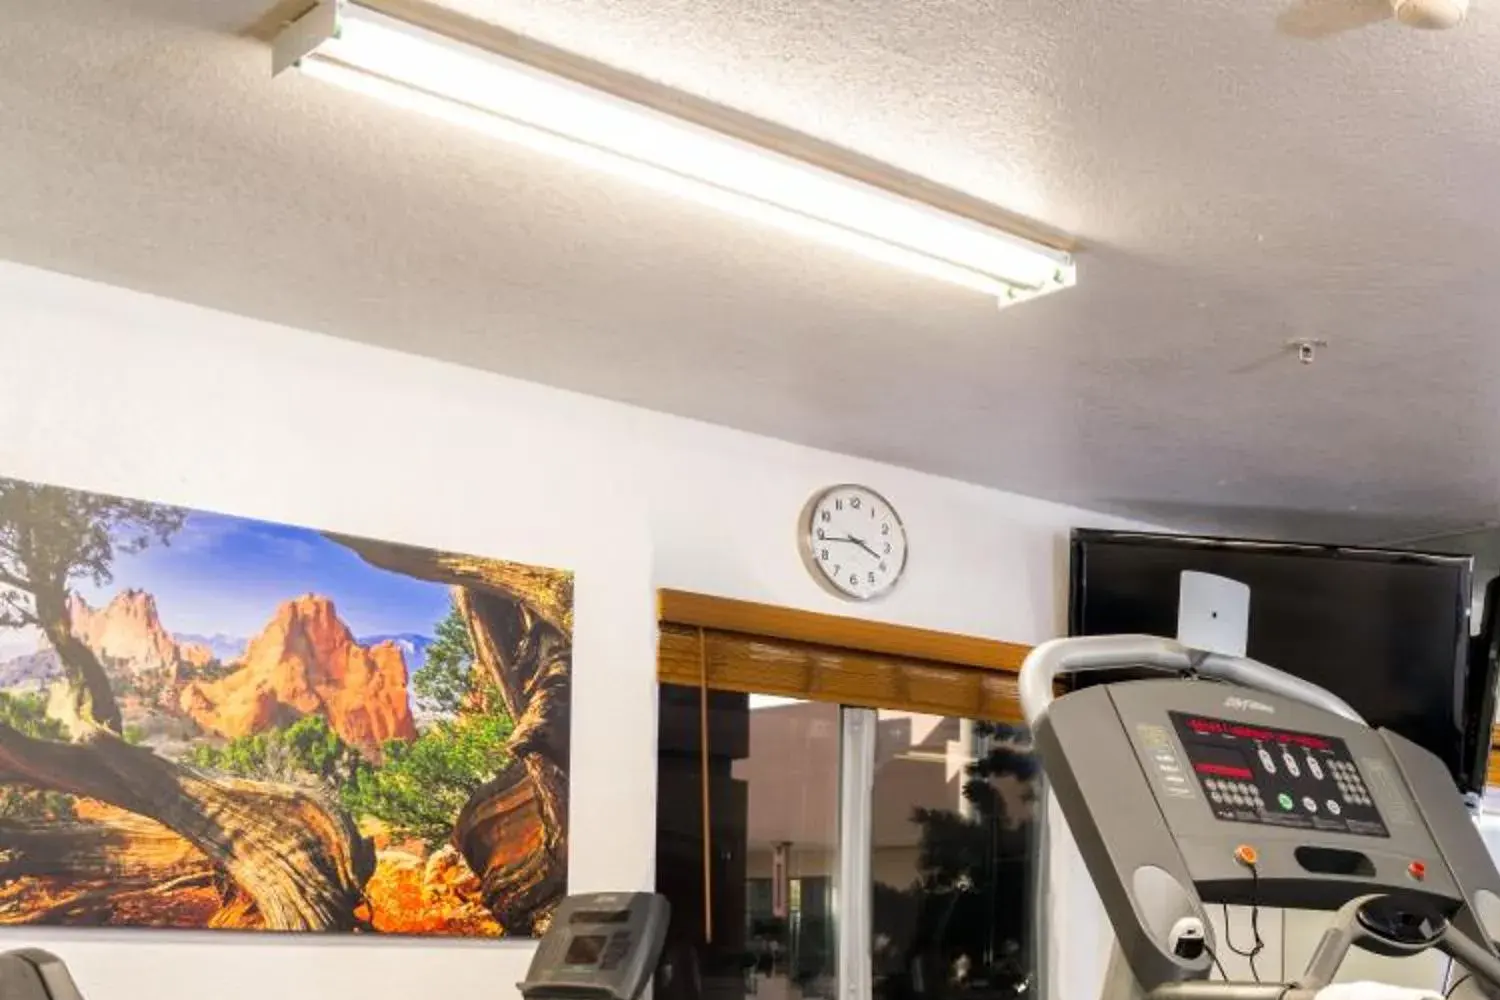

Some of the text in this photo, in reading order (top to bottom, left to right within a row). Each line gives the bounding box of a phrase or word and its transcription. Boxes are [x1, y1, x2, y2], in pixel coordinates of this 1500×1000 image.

[835, 499, 843, 511] 11
[882, 523, 889, 535] 2
[884, 543, 893, 554] 3
[822, 550, 829, 560] 8
[834, 565, 841, 577] 7
[850, 574, 858, 585] 6
[868, 572, 875, 583] 5
